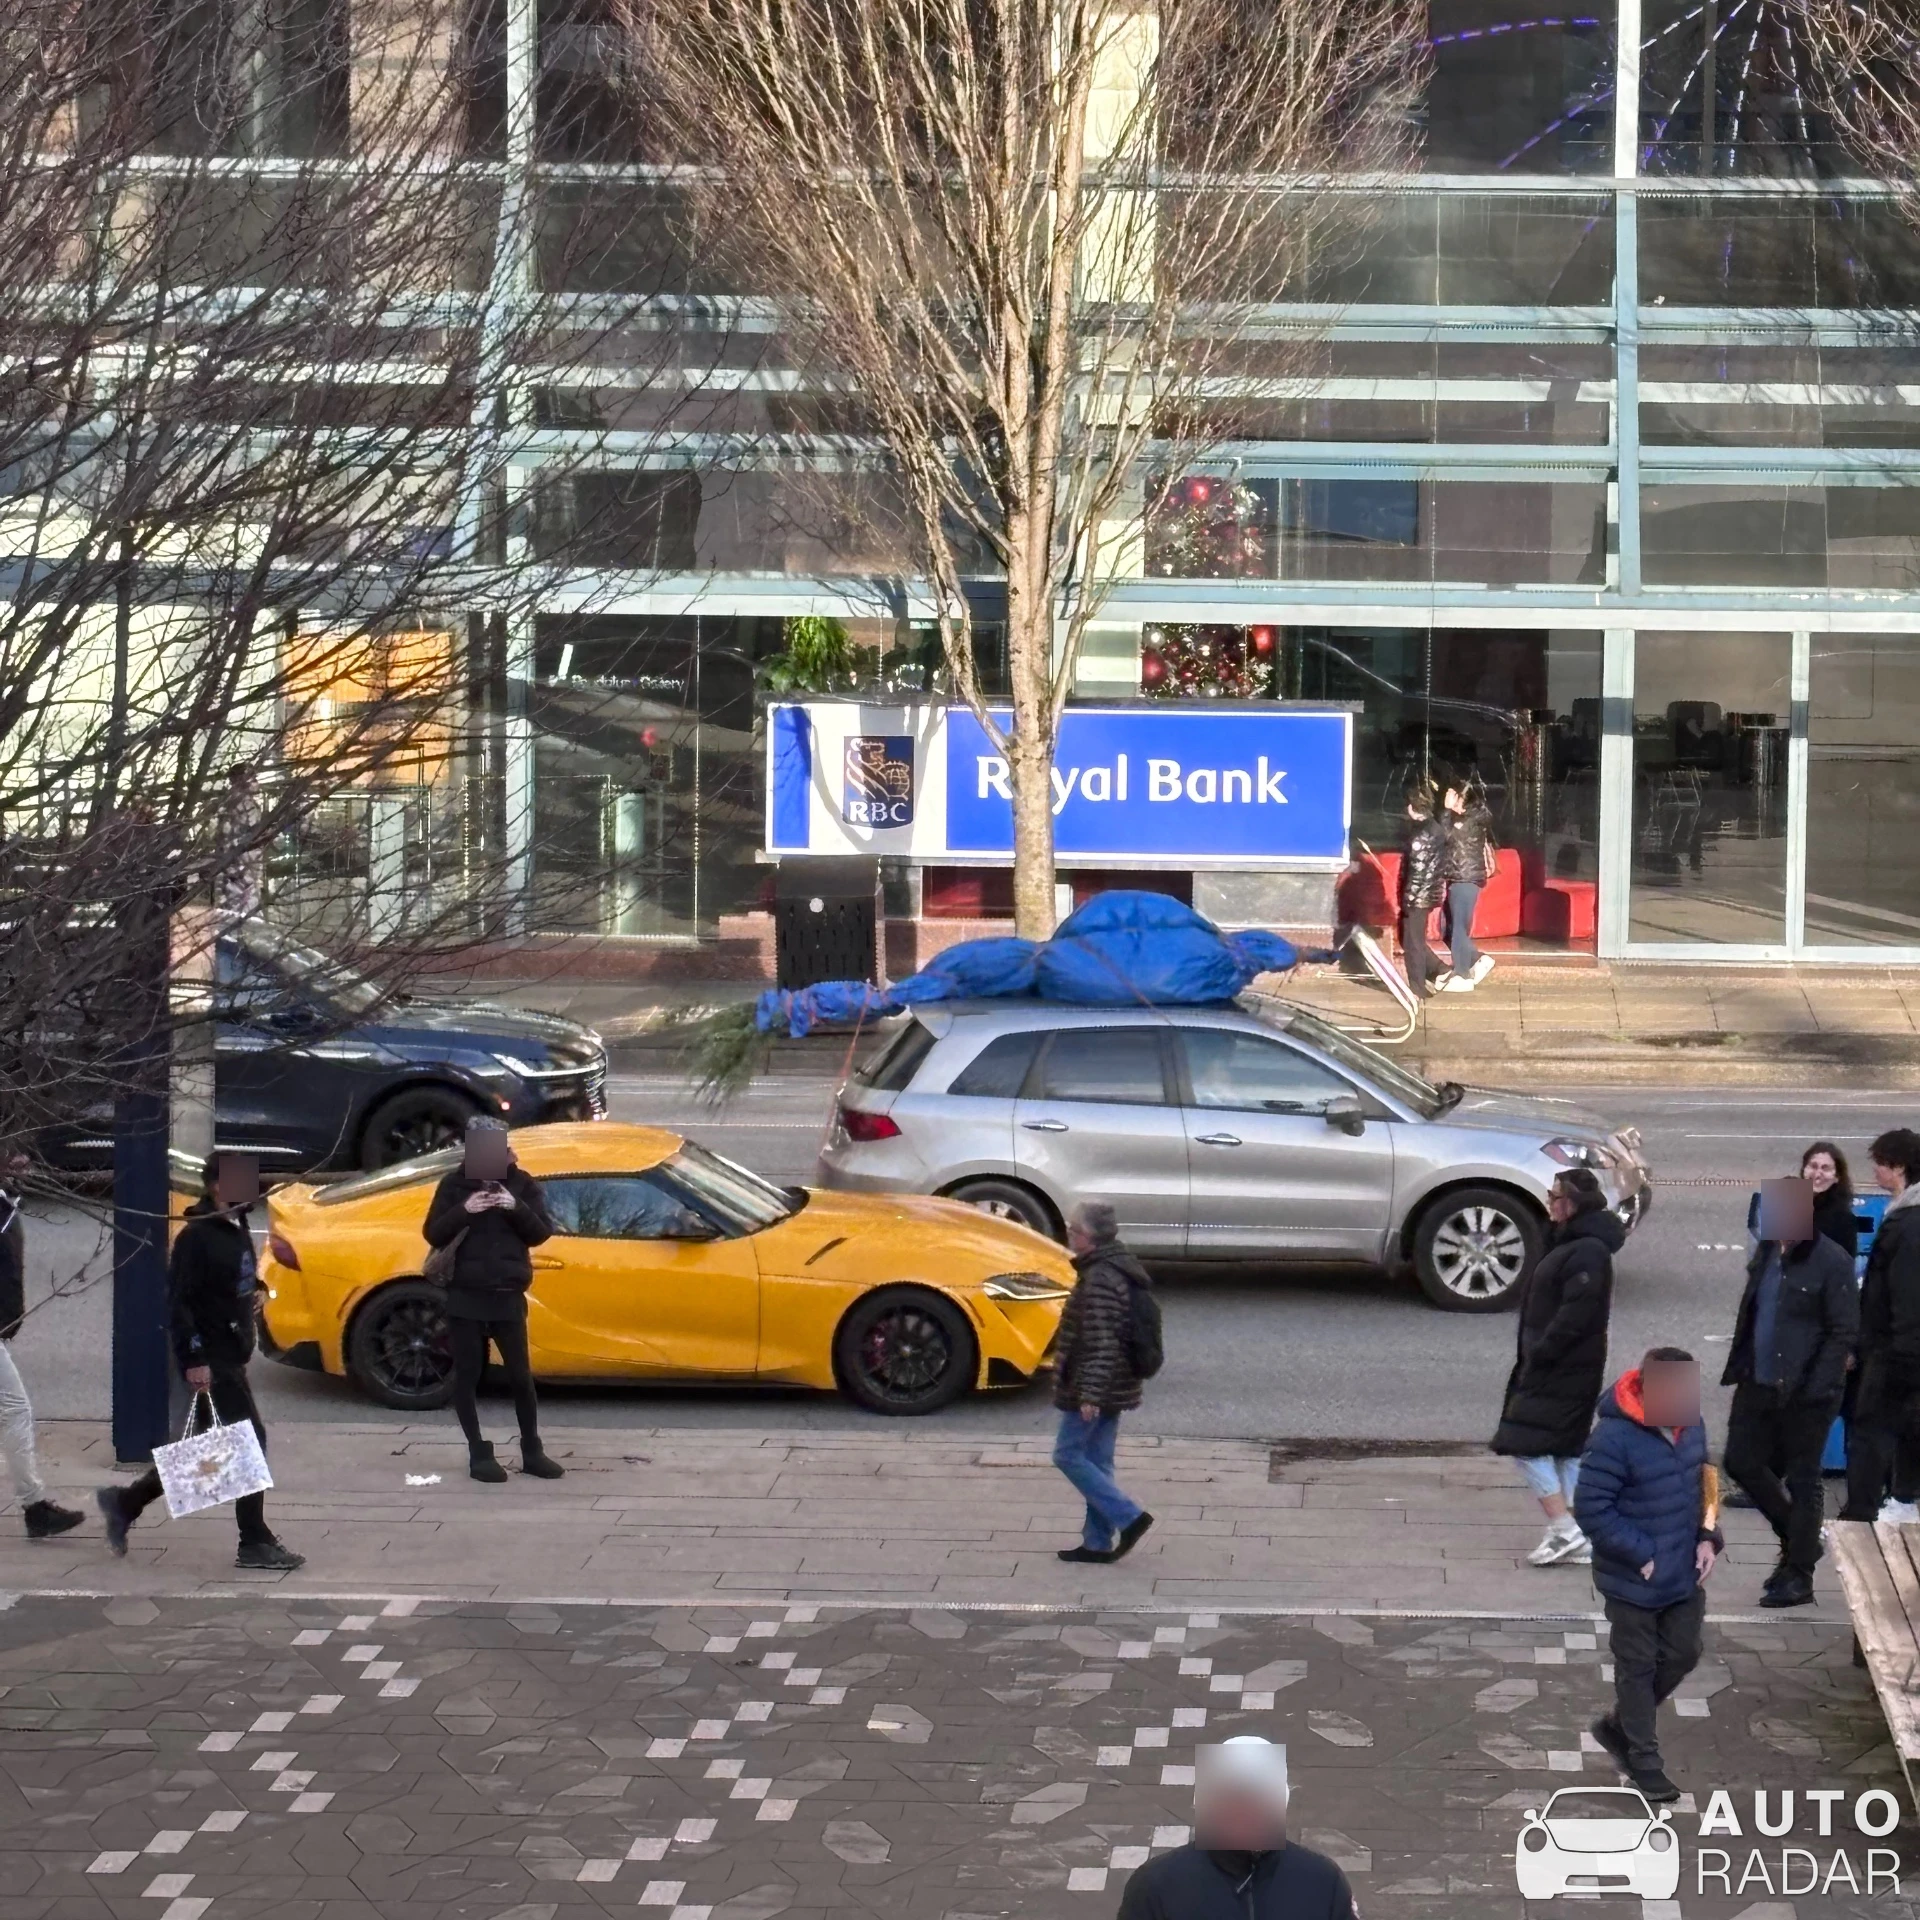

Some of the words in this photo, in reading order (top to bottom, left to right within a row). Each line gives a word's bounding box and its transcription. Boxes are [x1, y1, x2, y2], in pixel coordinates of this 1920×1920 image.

[976, 753, 1128, 815] Ryal
[1148, 755, 1289, 804] Bank
[849, 801, 907, 822] RBC
